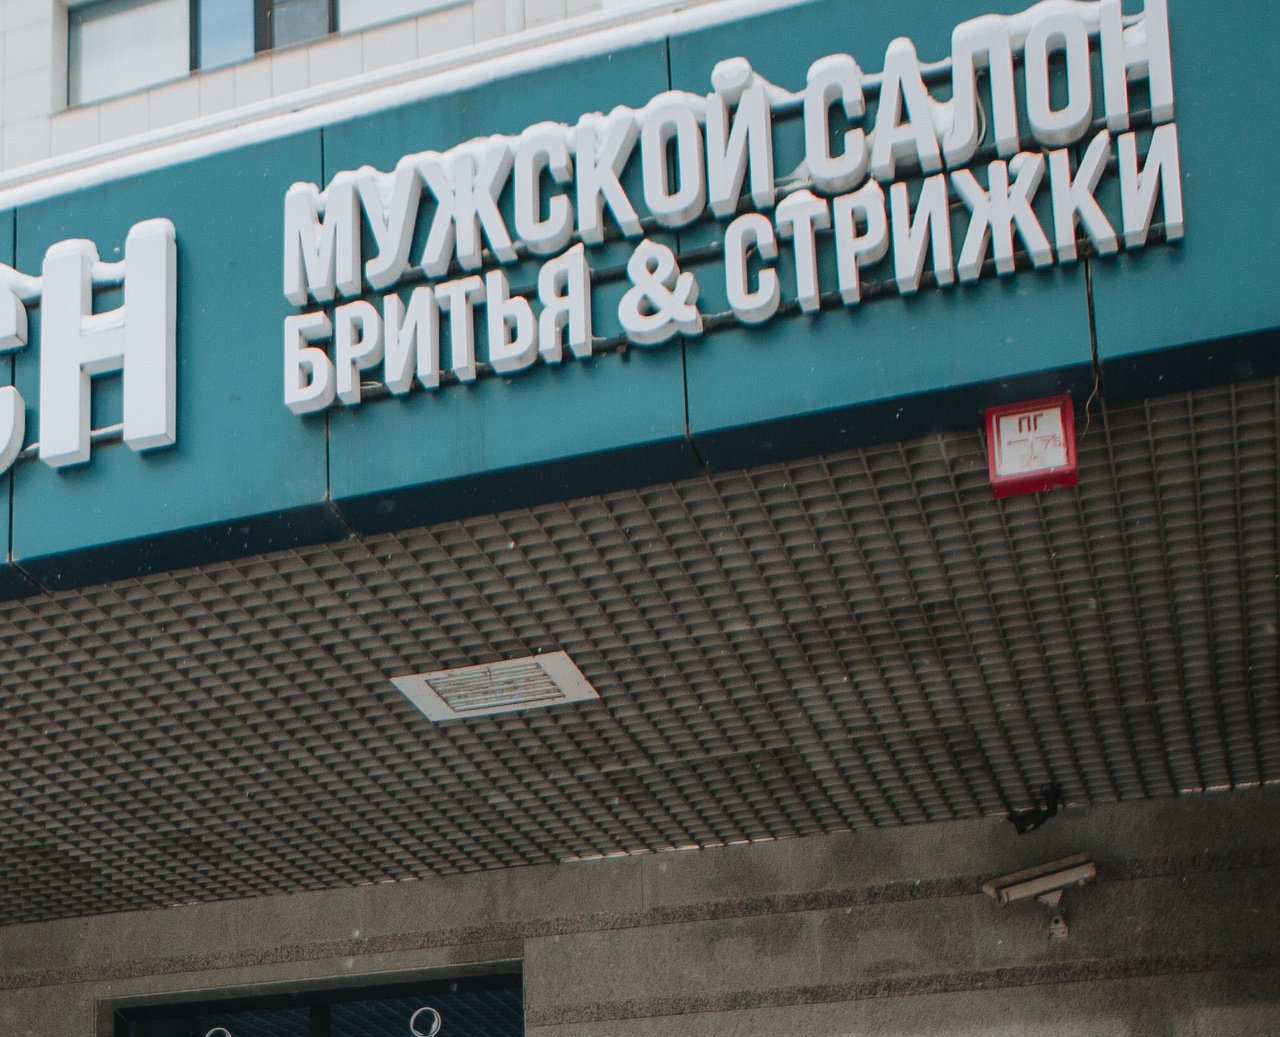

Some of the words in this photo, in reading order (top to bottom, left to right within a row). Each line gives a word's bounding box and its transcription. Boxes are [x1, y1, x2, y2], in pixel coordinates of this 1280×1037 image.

[283, 57, 776, 305] МУЖСКОЙ
[803, 0, 1177, 195] САЛОН
[283, 244, 593, 416] БРИТЬЯ
[618, 238, 704, 347] &
[723, 123, 1186, 325] СТРИЖКИ
